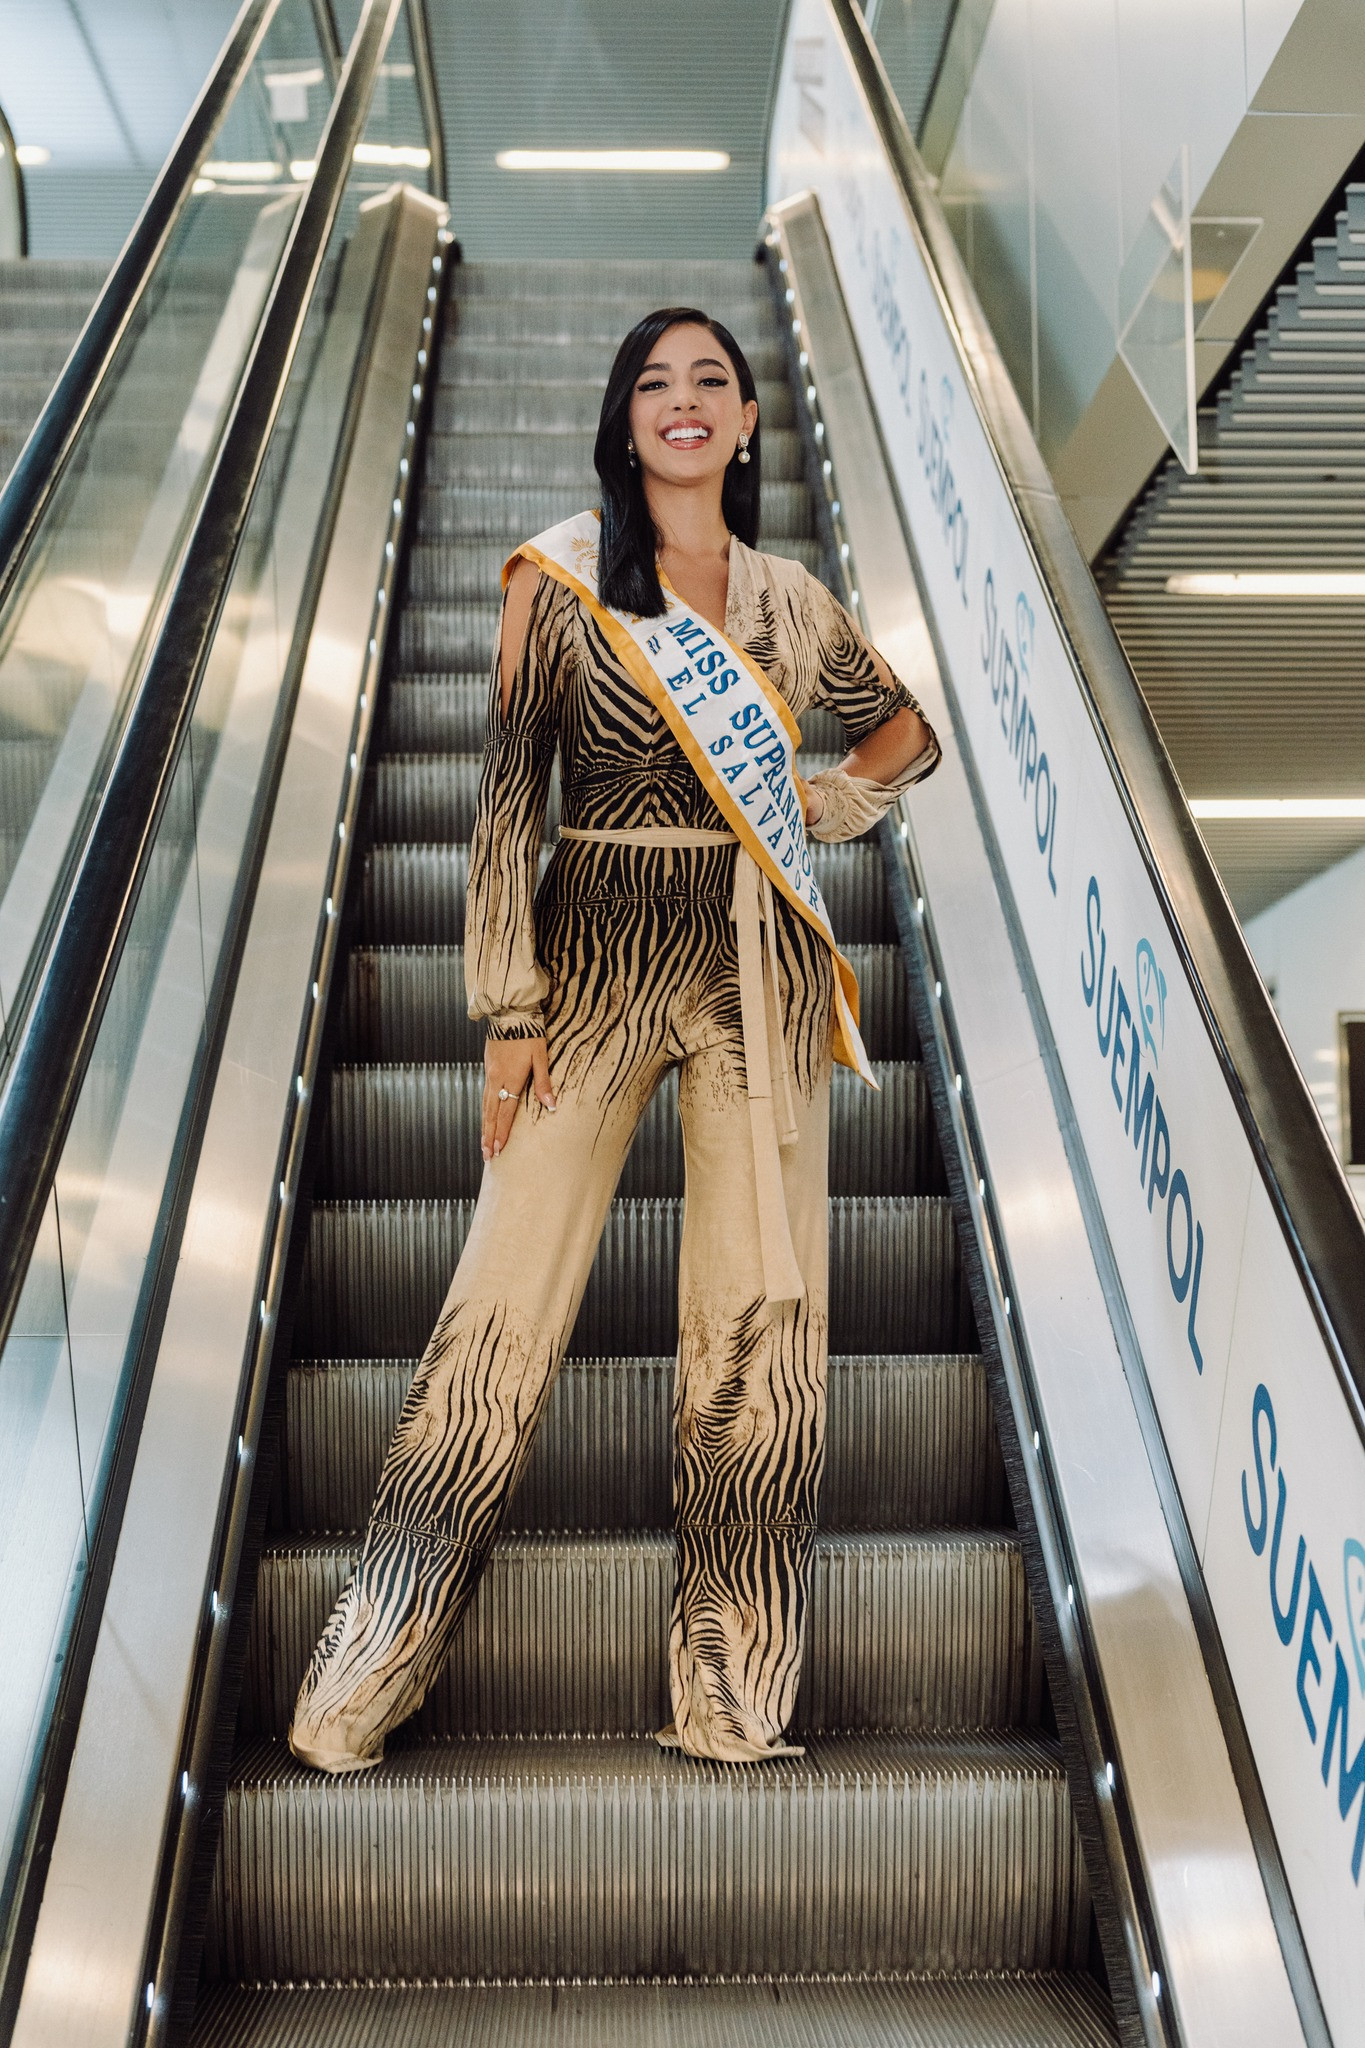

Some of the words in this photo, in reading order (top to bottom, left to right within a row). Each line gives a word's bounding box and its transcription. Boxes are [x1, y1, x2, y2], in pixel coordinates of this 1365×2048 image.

[666, 617, 740, 695] MISS
[729, 703, 820, 891] SUPRANATIO
[666, 667, 707, 716] EL
[708, 735, 819, 912] SALVADOR
[981, 567, 1057, 898] SUEMPOL
[1081, 875, 1203, 1376] SUEMPOL
[1241, 1383, 1365, 1888] SUEM
